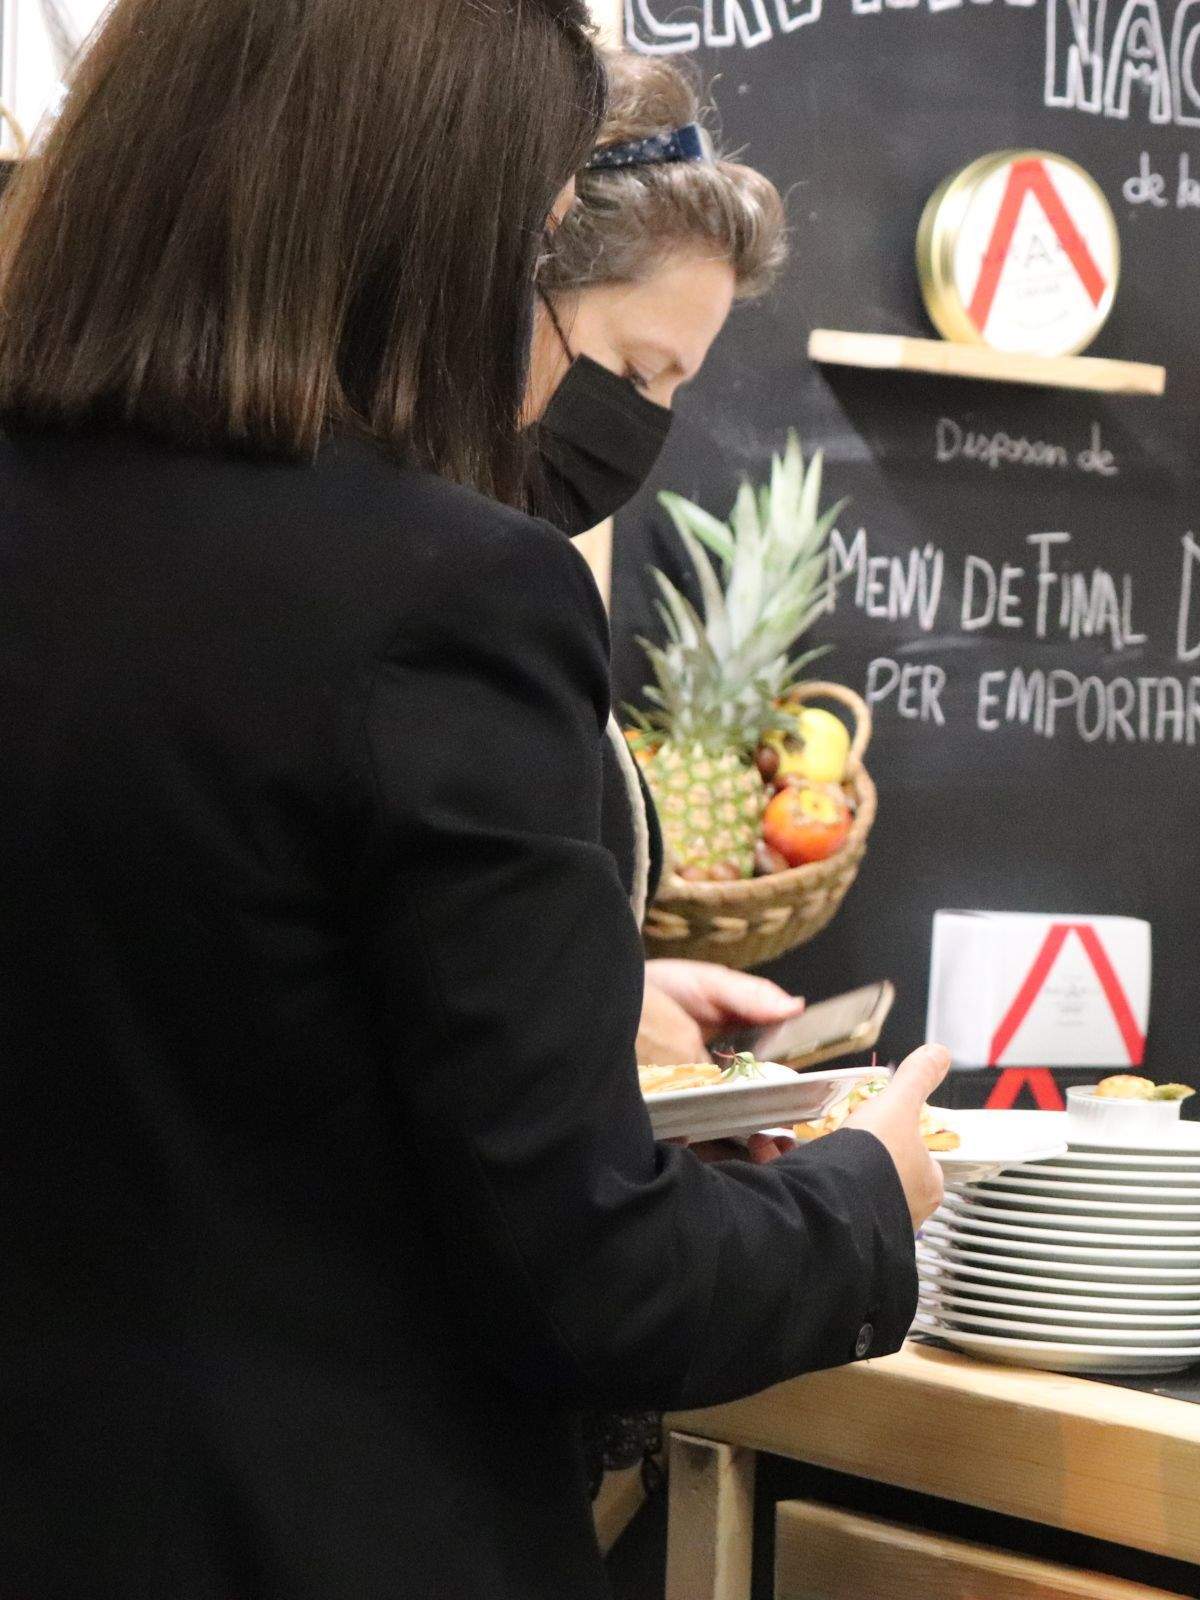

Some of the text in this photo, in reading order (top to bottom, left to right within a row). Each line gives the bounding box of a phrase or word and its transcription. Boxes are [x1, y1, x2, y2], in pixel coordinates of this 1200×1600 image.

[1122, 151, 1167, 208] de
[1076, 422, 1119, 476] de
[961, 555, 1024, 632] DE
[867, 657, 946, 727] PER
